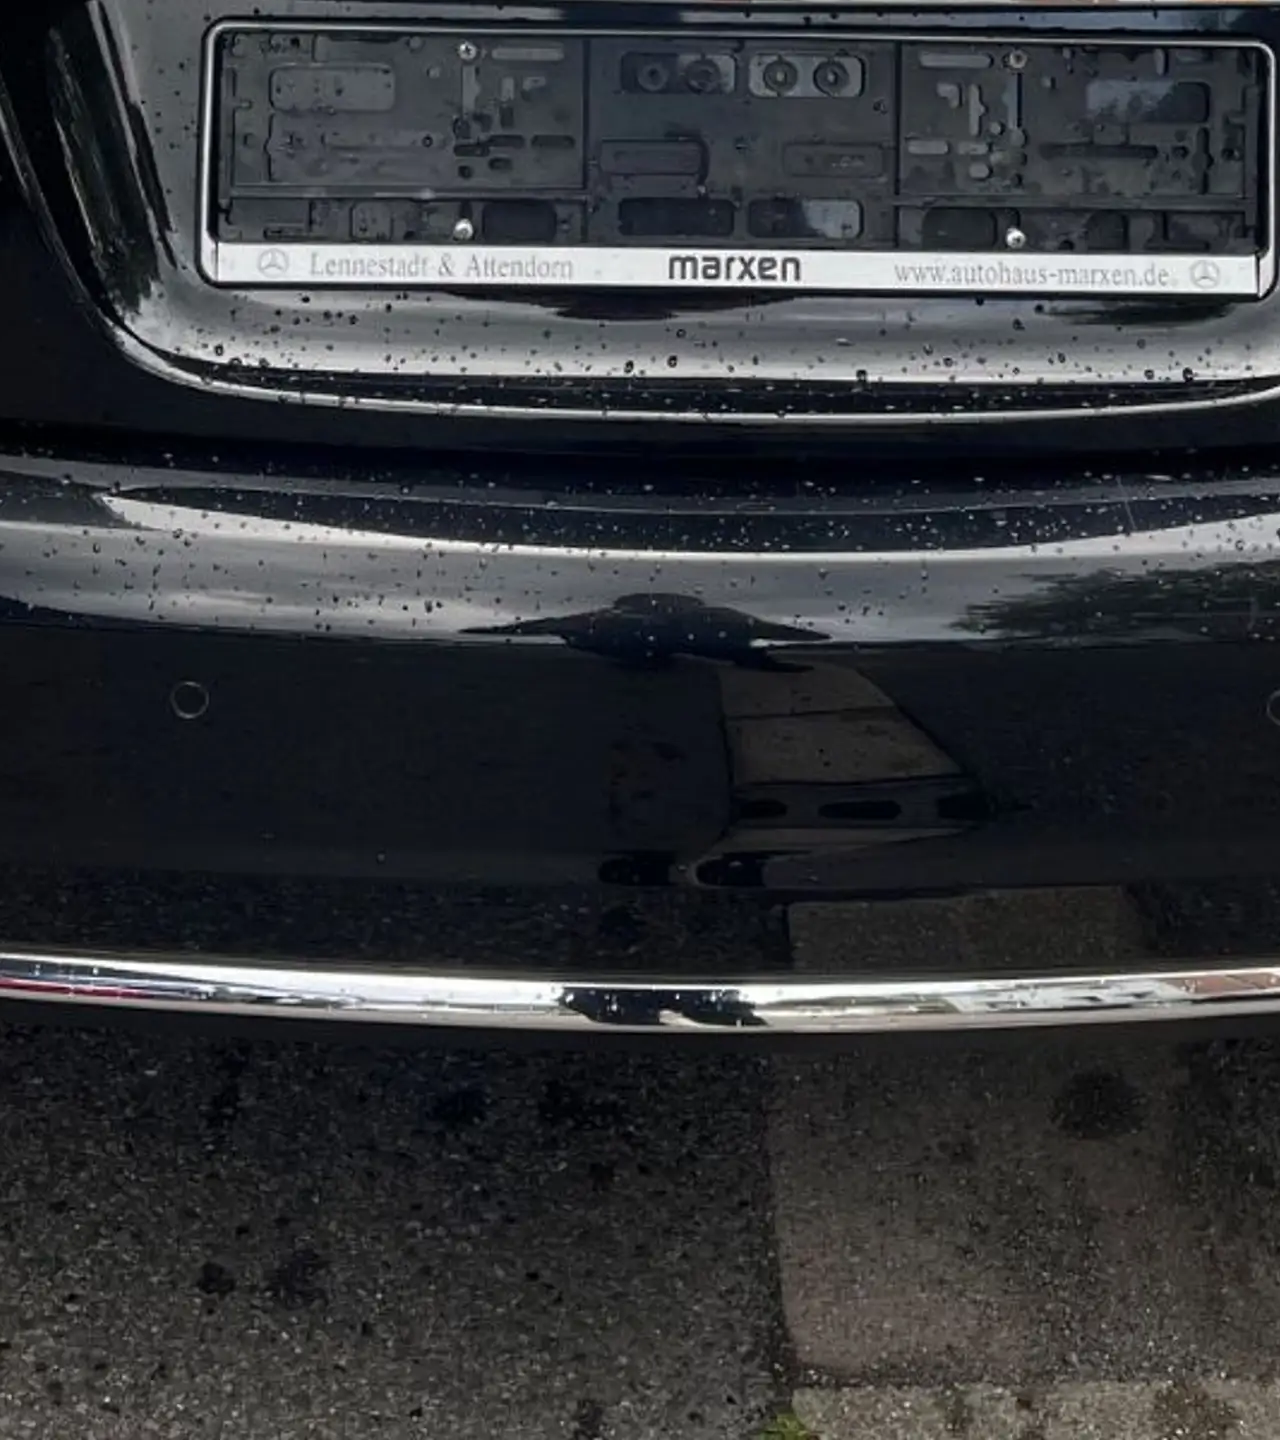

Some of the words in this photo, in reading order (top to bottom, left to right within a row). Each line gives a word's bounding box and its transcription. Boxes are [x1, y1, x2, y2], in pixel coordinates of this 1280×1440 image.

[309, 252, 428, 278] Lennestadt
[438, 252, 455, 278] &
[465, 253, 574, 279] Attendorn
[668, 255, 802, 282] marxen
[893, 260, 1169, 287] www.autohaus-marxen.de
